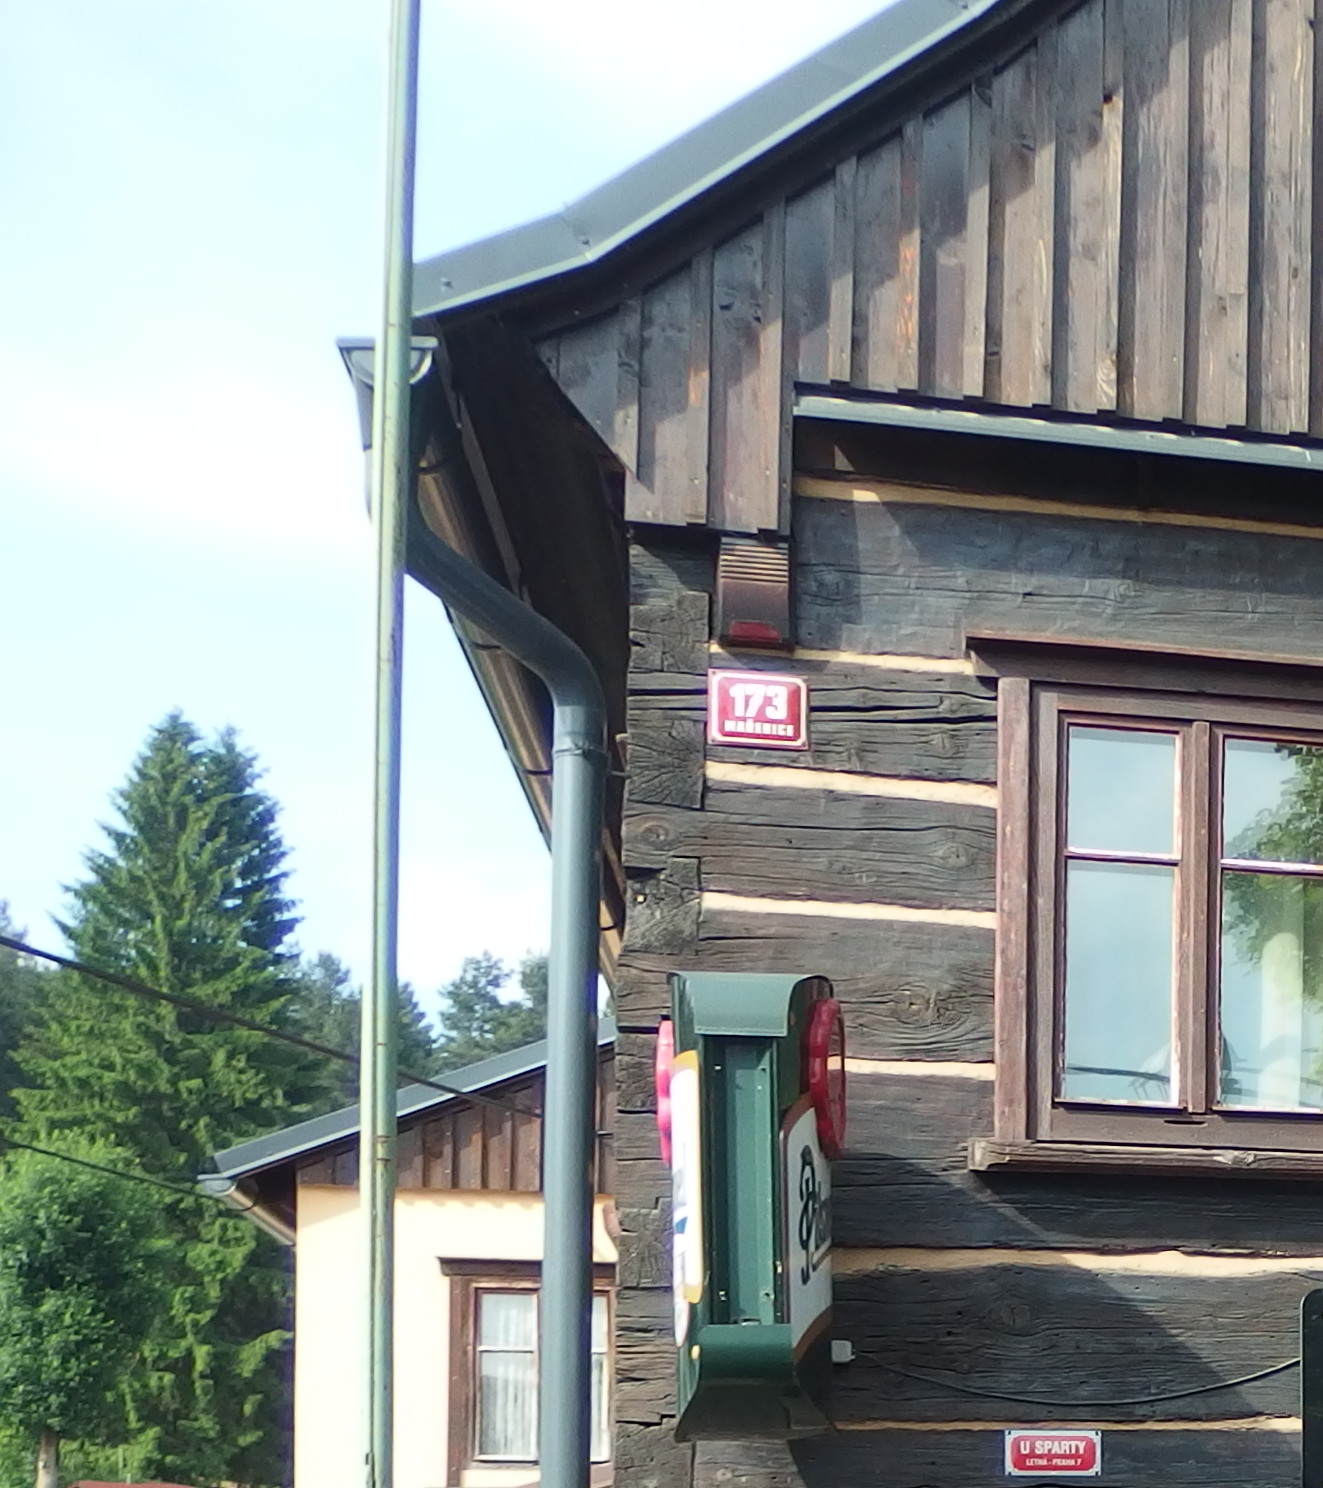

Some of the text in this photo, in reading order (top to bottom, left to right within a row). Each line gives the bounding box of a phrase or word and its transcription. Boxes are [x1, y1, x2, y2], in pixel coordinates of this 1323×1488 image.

[729, 683, 788, 720] 173
[1020, 1440, 1087, 1455] U SPARTY
